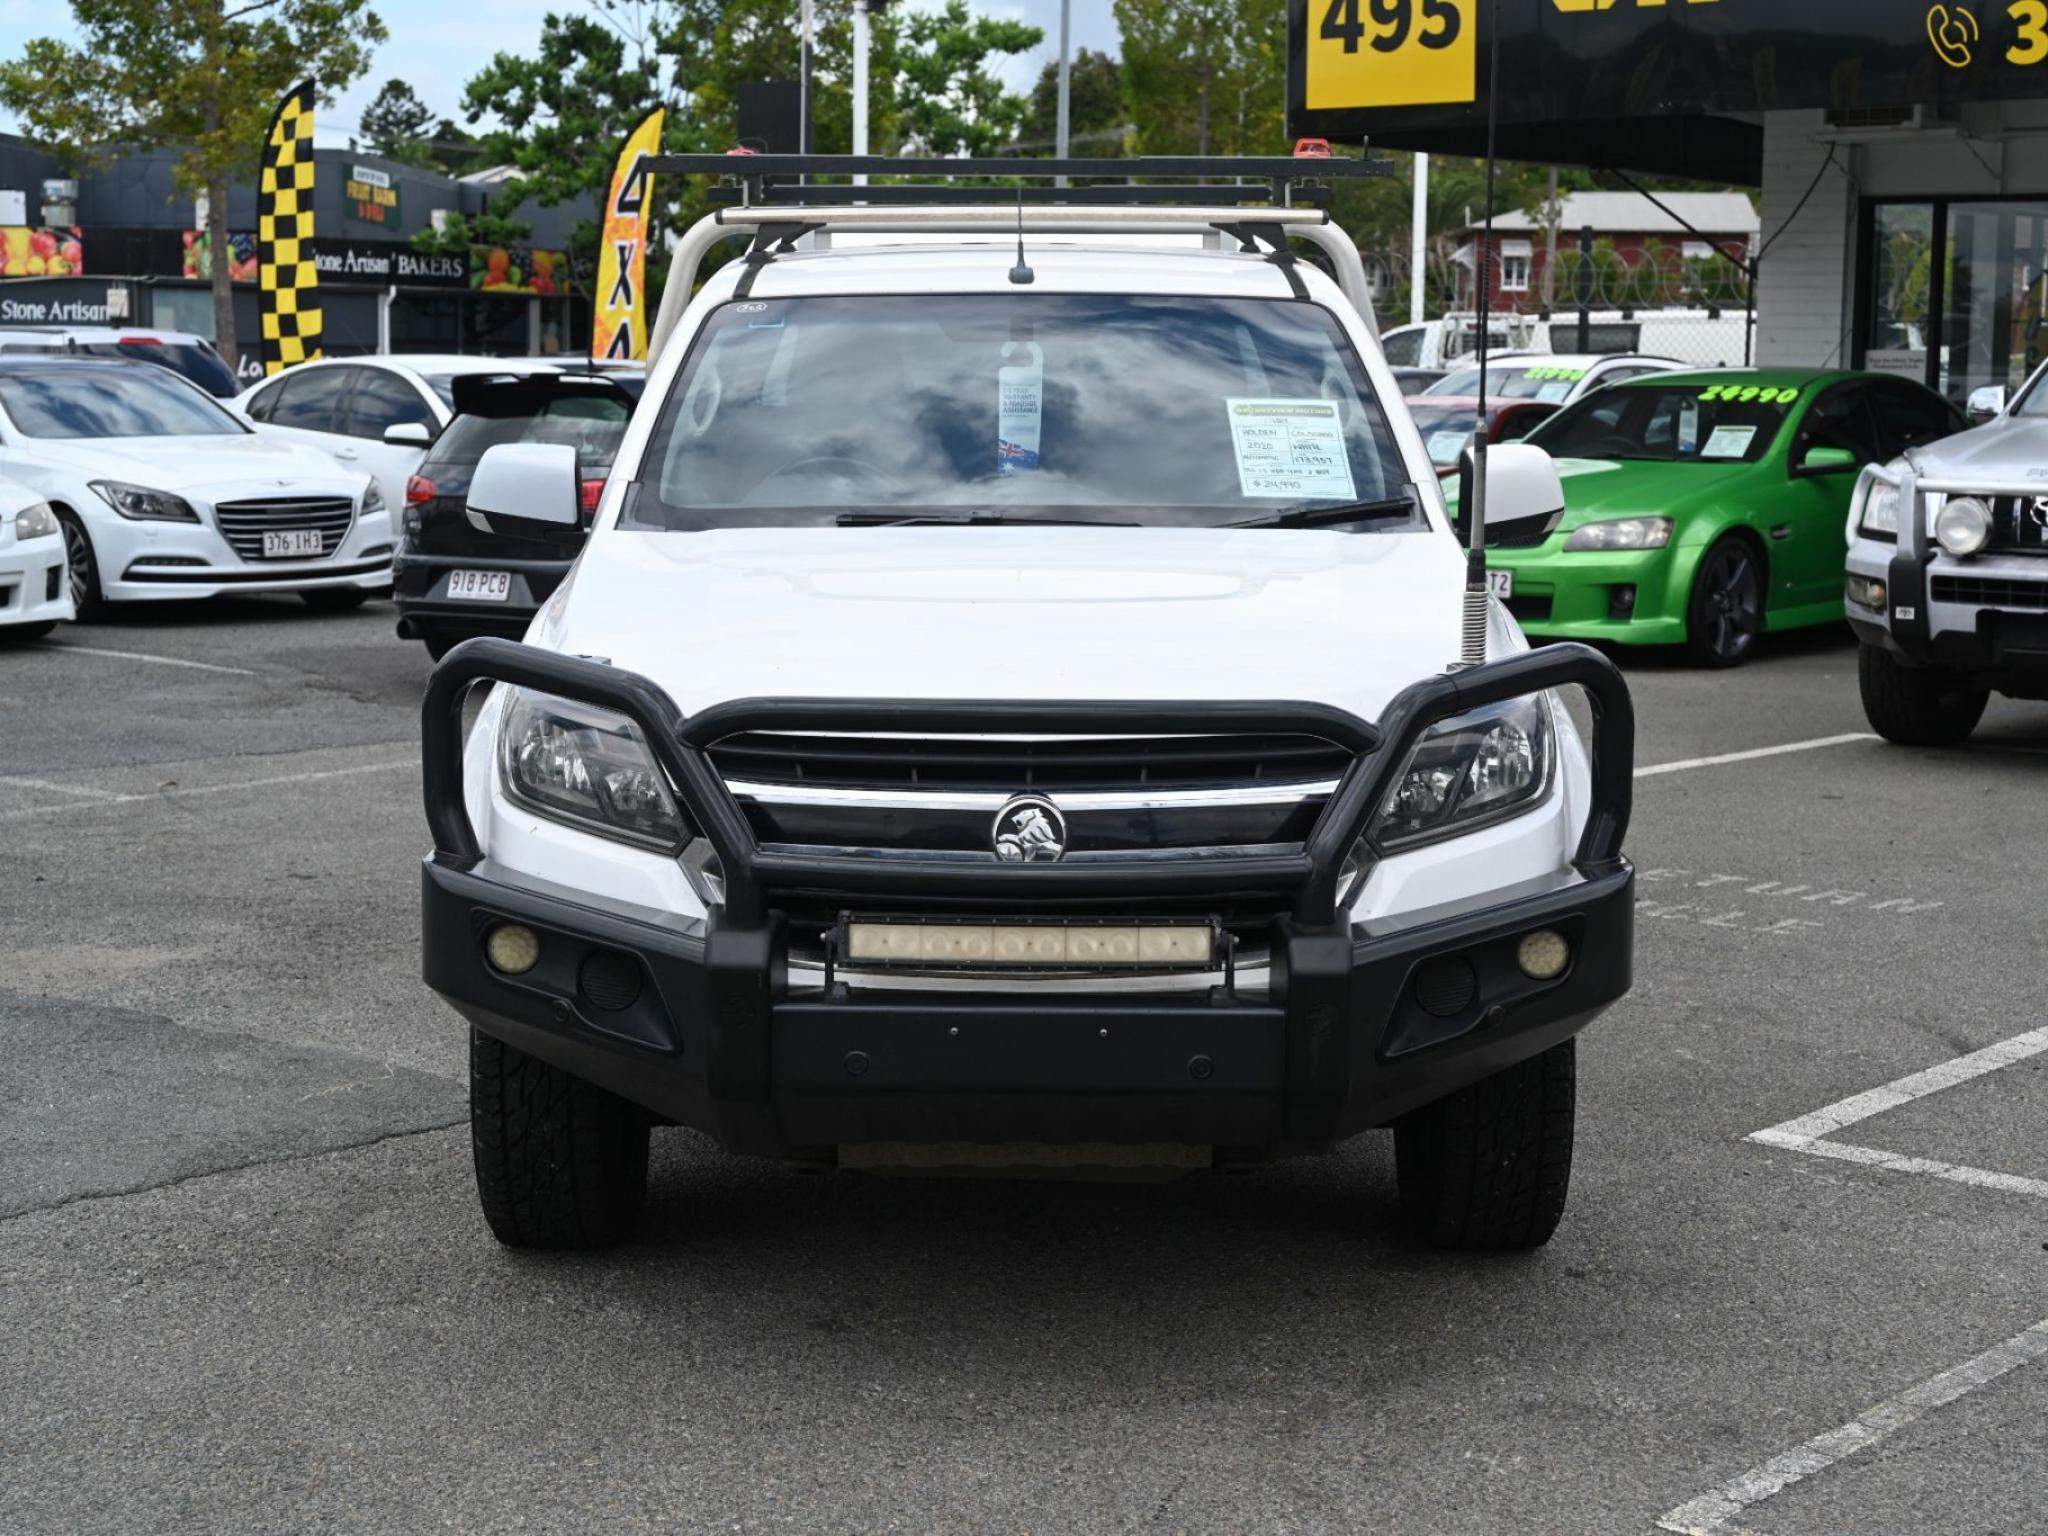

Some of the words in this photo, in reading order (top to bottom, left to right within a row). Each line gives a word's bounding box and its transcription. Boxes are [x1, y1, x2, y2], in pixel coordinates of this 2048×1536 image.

[1320, 0, 1461, 54] 495
[313, 249, 343, 271] tone
[398, 255, 464, 277] BAKERS
[1, 299, 47, 320] Stone
[48, 299, 110, 321] Artisan
[1698, 385, 1798, 404] 24990
